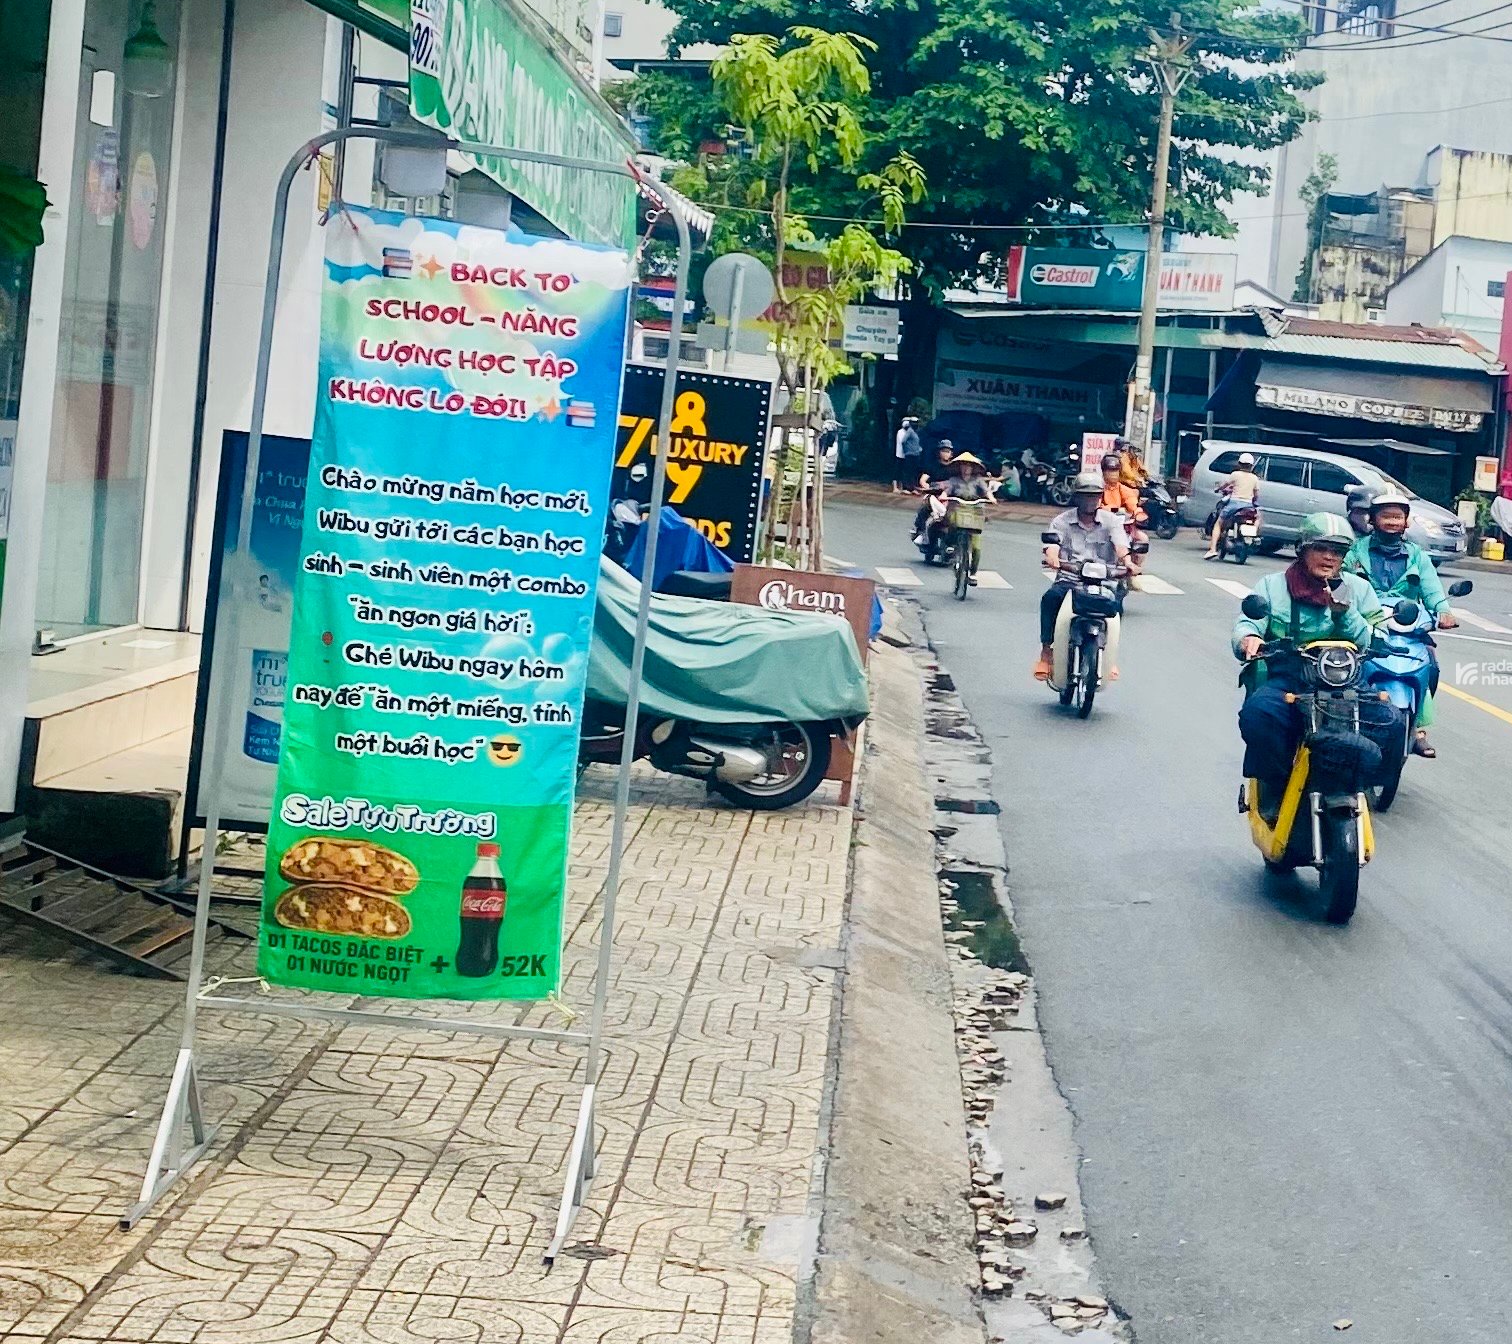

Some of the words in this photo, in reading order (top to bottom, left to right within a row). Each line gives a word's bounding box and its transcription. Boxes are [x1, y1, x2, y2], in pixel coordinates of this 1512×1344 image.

[451, 263, 526, 287] BACK
[534, 273, 570, 292] TO
[1046, 267, 1094, 285] Castrol
[1185, 272, 1224, 293] THANH
[366, 299, 474, 326] SCHOOL
[501, 307, 577, 337] NĂNG
[360, 339, 452, 369] LƯỢNG
[459, 350, 516, 376] HỌC
[523, 353, 575, 382] TẬP
[331, 379, 423, 408] KHÔNG
[430, 390, 465, 411] LO
[470, 394, 527, 418] ĐÓI!
[1026, 383, 1089, 403] THANH
[1283, 392, 1349, 409] MILANO
[1360, 404, 1426, 421] COFFEE
[651, 434, 748, 465] LUXURY
[322, 466, 376, 490] Chào
[382, 475, 444, 501] mừng
[450, 481, 494, 503] năm
[500, 486, 538, 509] học
[544, 491, 589, 514] mới,
[319, 509, 369, 533] Wibu
[375, 517, 411, 538] gửi
[415, 520, 448, 541] tới
[453, 524, 493, 545] các
[498, 528, 539, 552] bạn
[544, 532, 583, 555] học
[304, 553, 343, 574] sinh
[369, 561, 412, 582] sinh
[419, 565, 463, 586] viên
[469, 570, 511, 592] một
[517, 576, 586, 595] combo
[759, 581, 845, 610] Cham
[389, 608, 440, 628] ngon
[446, 611, 476, 631] giá
[345, 642, 392, 665] Ghé
[400, 647, 453, 671] Wibu
[460, 660, 514, 679] ngay
[520, 659, 564, 680] hôm
[296, 685, 332, 707] nay
[335, 685, 363, 706] để
[408, 695, 451, 718] một
[457, 698, 527, 724] miếng,
[534, 703, 572, 723] tỉnh
[337, 733, 377, 758] một
[382, 734, 428, 755] buổi
[284, 796, 348, 828] Sale
[346, 799, 398, 832] Tựu
[395, 805, 496, 838] Trường
[268, 934, 286, 949] 01
[291, 935, 341, 956] TACOS
[287, 956, 305, 971] 01
[309, 956, 358, 977] NƯỚC
[364, 963, 411, 984] NGỌT
[501, 954, 548, 977] 52K
